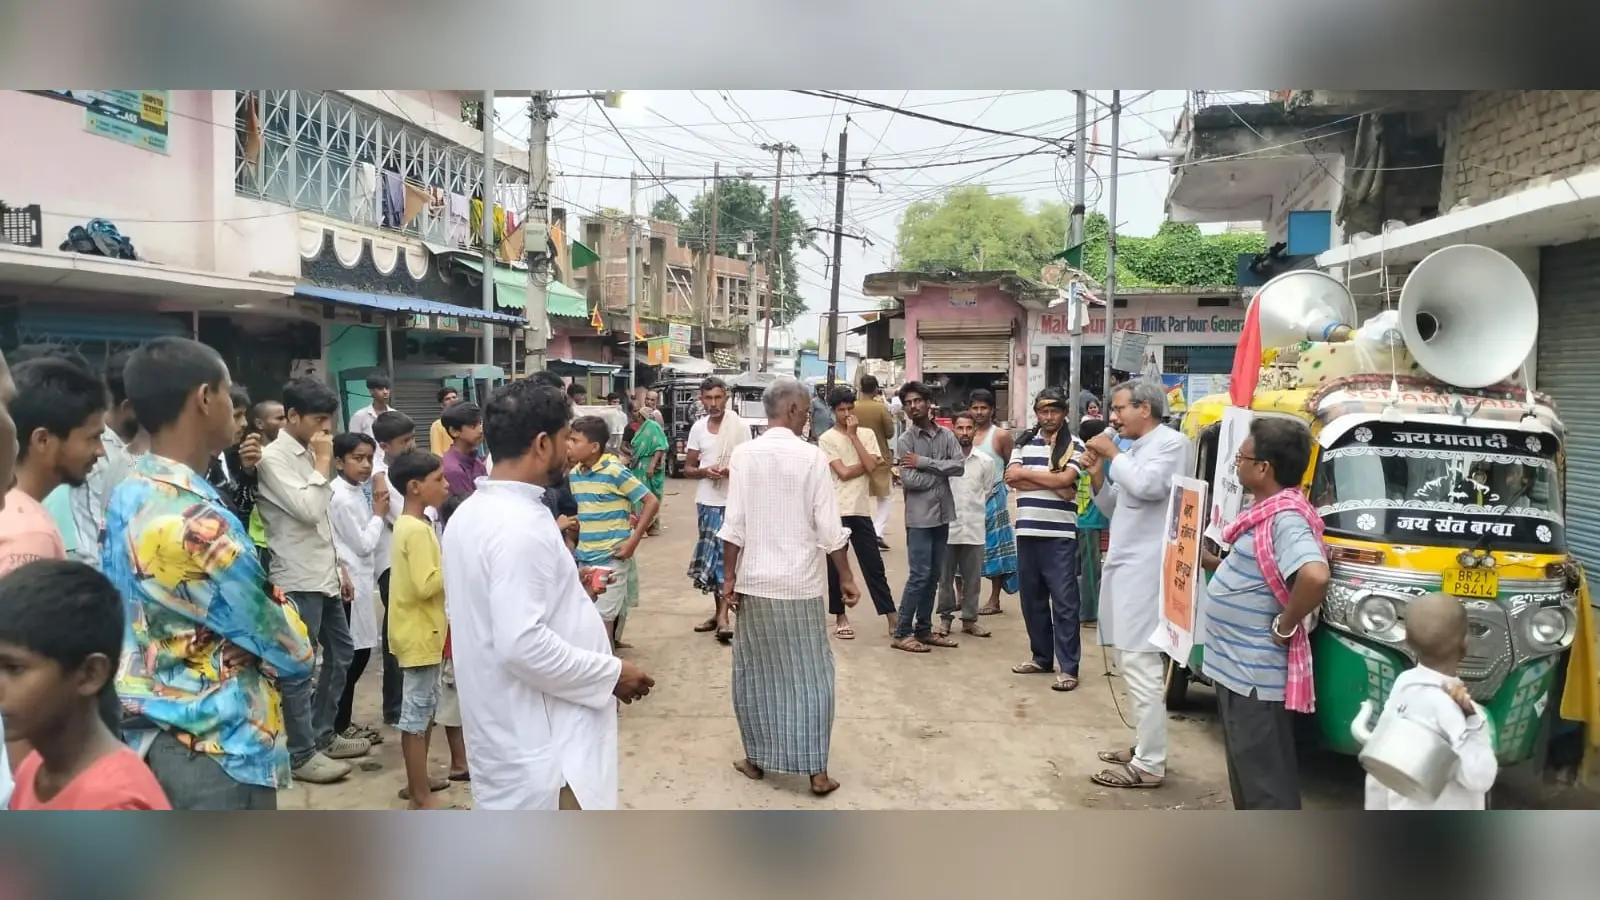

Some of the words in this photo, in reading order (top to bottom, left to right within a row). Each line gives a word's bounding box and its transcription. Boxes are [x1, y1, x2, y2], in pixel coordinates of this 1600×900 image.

[1141, 316, 1167, 333] Milk
[1168, 316, 1208, 333] Parlour
[1392, 431, 1431, 444] जय
[1432, 433, 1482, 447] माता
[1485, 433, 1508, 449] दी
[1397, 516, 1431, 531] जय
[1434, 516, 1468, 533] संत
[1470, 521, 1515, 537] बाबा
[1458, 570, 1488, 584] BR21
[1455, 582, 1493, 596] P9414
